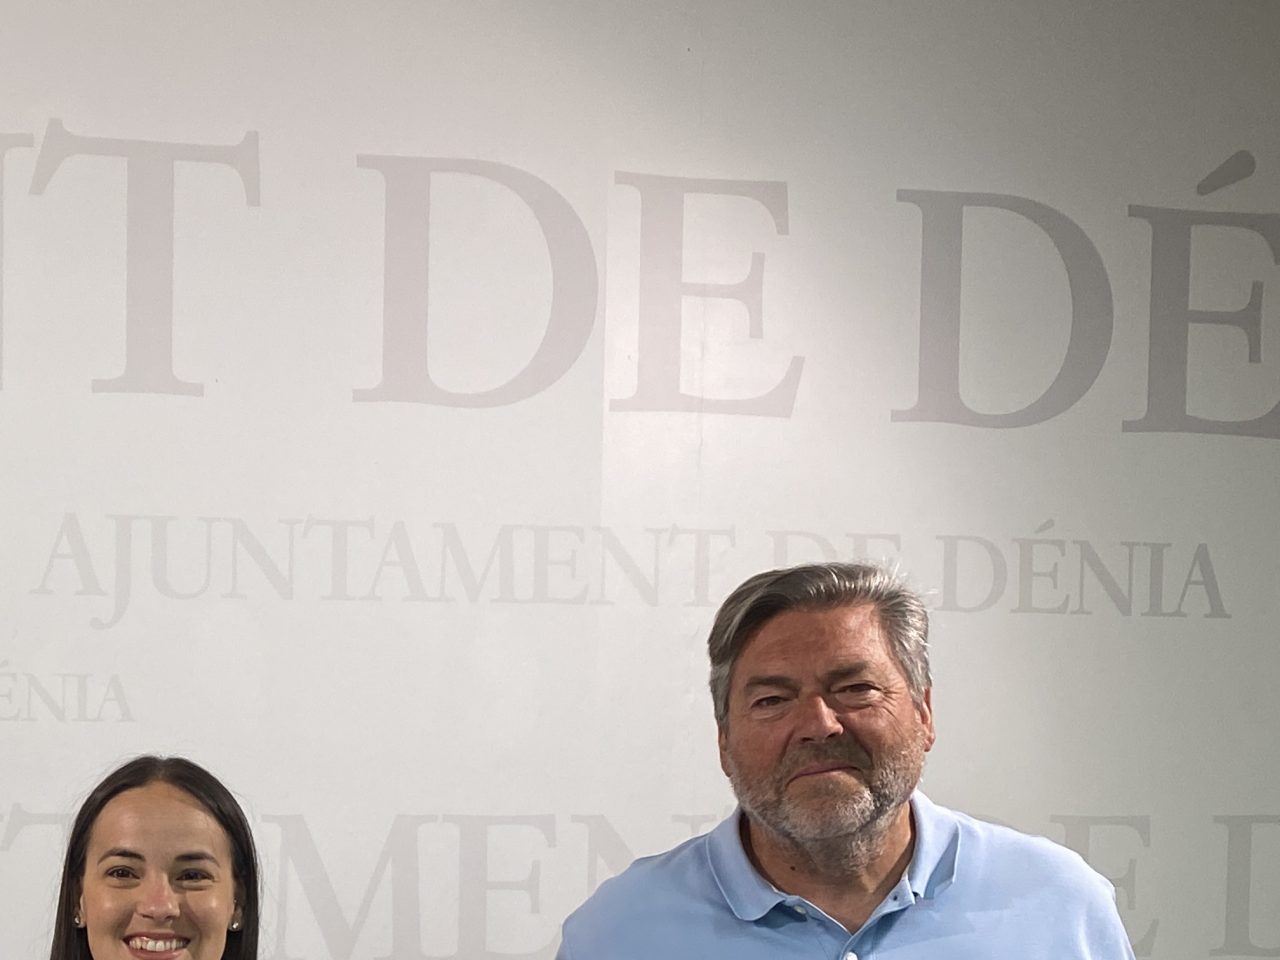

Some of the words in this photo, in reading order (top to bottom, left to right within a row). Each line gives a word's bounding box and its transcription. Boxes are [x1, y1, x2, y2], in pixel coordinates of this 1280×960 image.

[353, 153, 806, 418] DE
[29, 511, 735, 630] AJUNTAMENT
[935, 518, 1232, 620] DÉNIA
